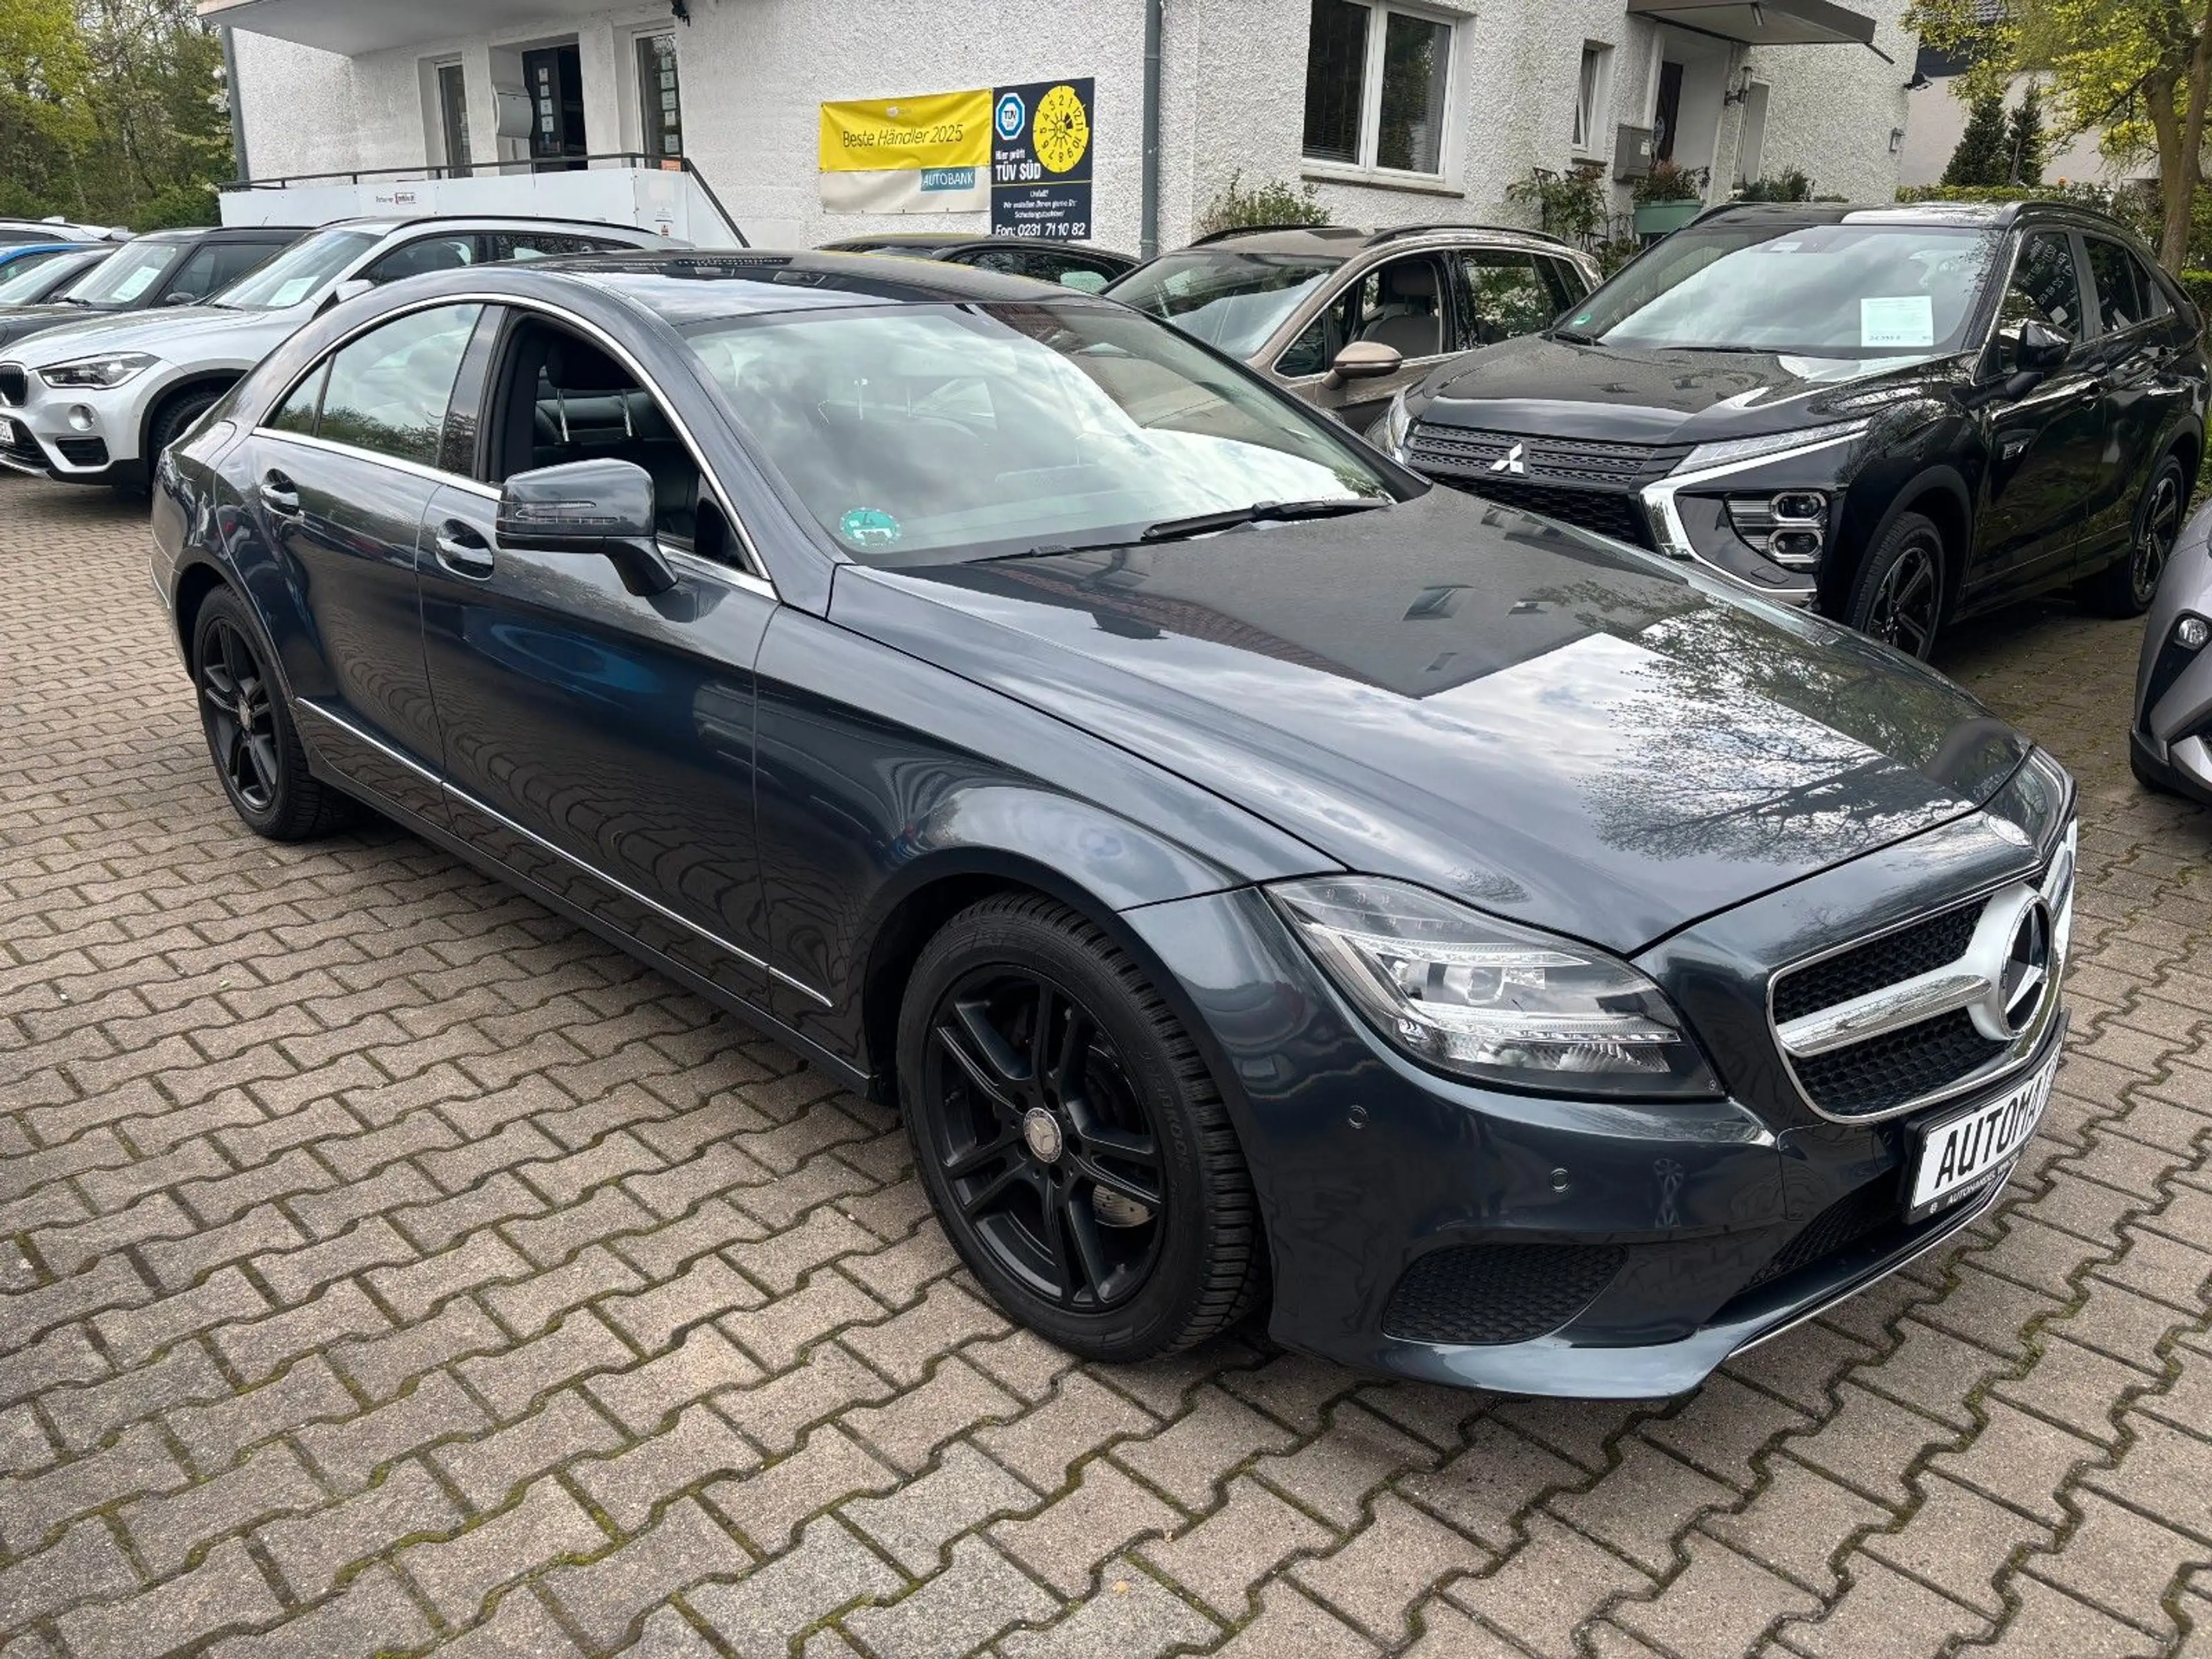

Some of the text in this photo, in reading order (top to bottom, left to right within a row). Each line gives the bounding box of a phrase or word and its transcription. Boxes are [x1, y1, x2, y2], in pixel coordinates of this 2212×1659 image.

[843, 124, 963, 147] Beste Händler 2025
[922, 172, 974, 186] AUTOBANK
[995, 160, 1041, 181] TÜV SÜD
[995, 224, 1016, 236] Fon:
[1017, 224, 1041, 236] 0231
[1071, 222, 1086, 236] 82
